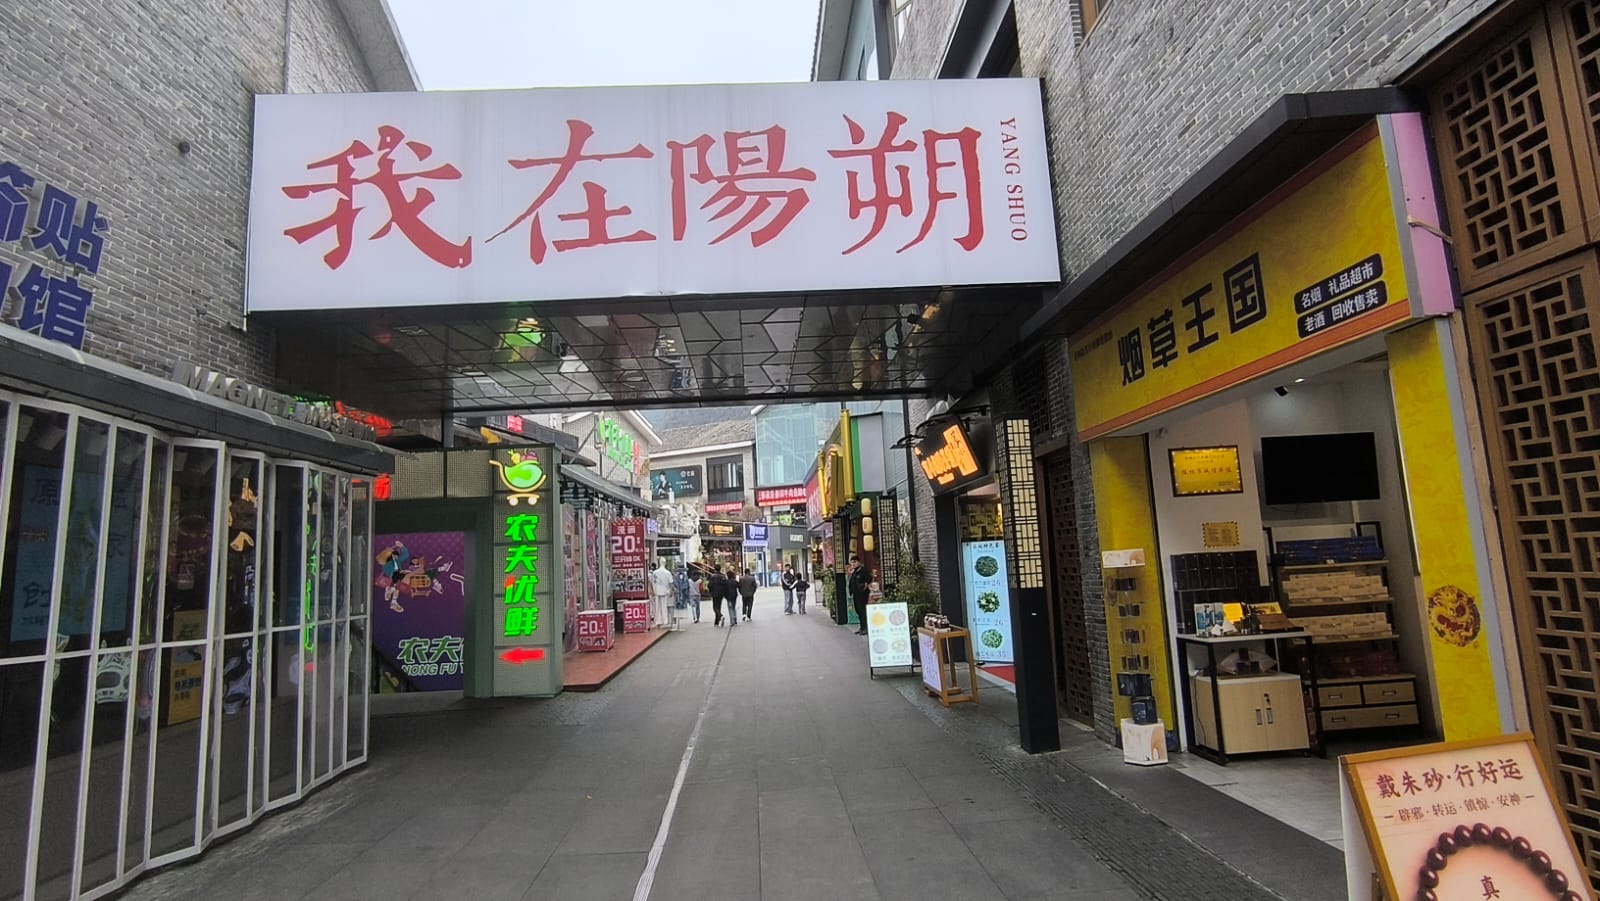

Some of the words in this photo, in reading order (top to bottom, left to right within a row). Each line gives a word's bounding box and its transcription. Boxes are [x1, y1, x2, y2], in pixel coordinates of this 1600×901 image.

[1000, 116, 1021, 175] YANG
[281, 111, 983, 270] 我在陽朔
[1007, 184, 1028, 241] SHUO
[0, 261, 94, 350] 馆
[1301, 286, 1322, 308] 名烟
[1327, 262, 1373, 295] 礼品超市
[1117, 252, 1267, 386] 烟草王国
[1304, 310, 1326, 332] 老酒
[1331, 288, 1379, 321] 回收售卖
[611, 535, 636, 554] 20
[503, 513, 538, 637] 农夫优鲜
[579, 620, 598, 635] 20
[625, 607, 640, 619] 20
[397, 635, 464, 664] 农夫
[439, 662, 458, 675] FU
[1481, 875, 1500, 900] 真
